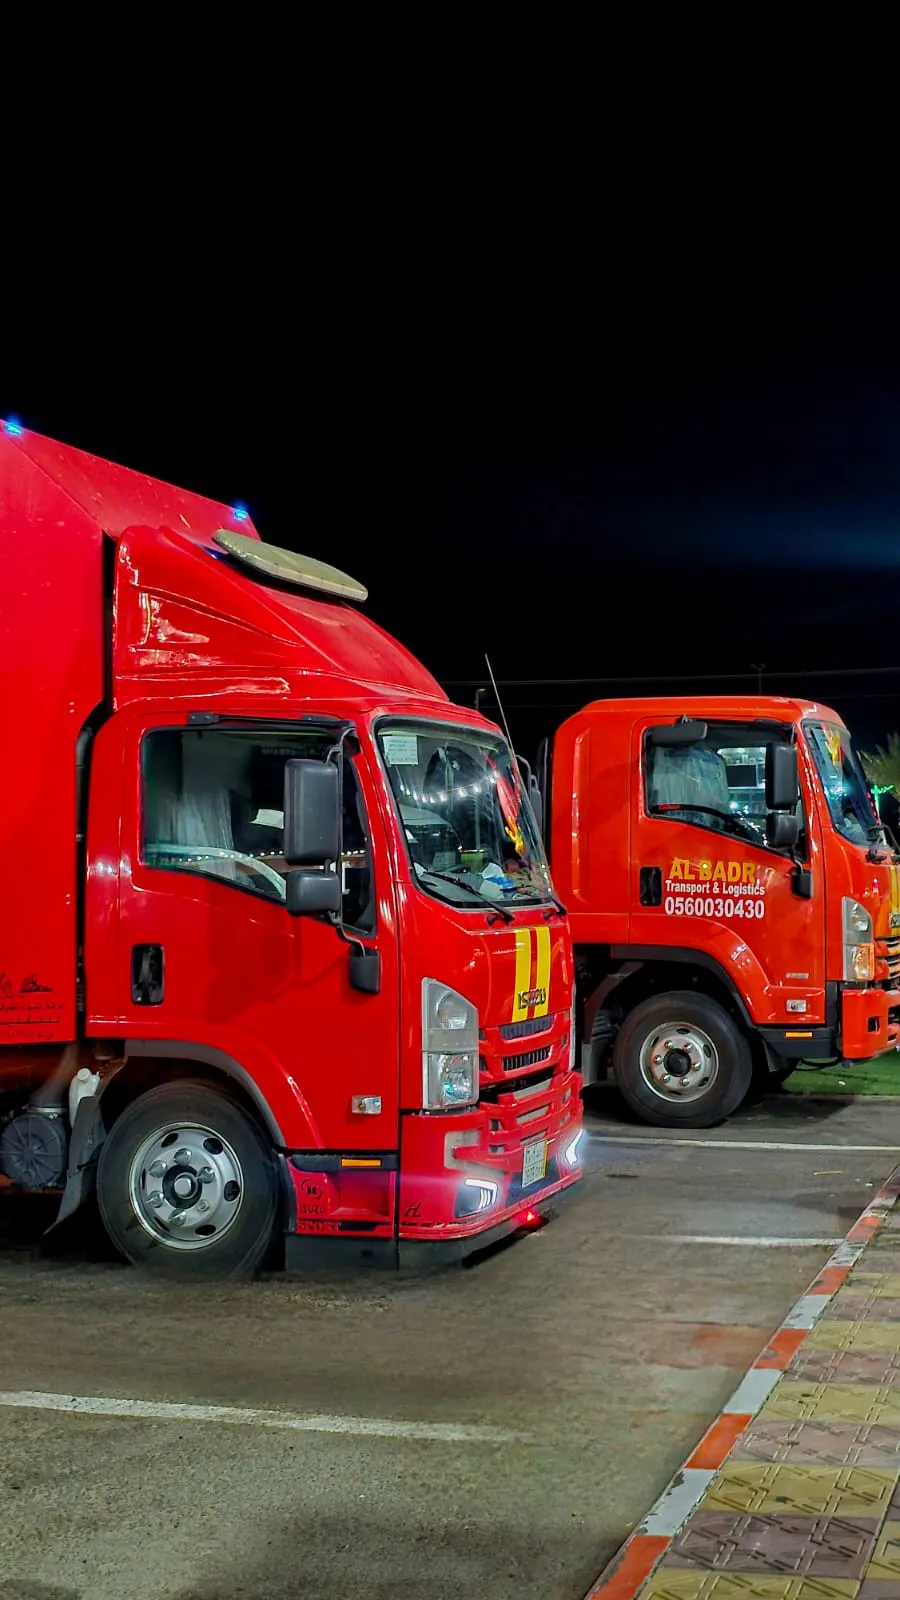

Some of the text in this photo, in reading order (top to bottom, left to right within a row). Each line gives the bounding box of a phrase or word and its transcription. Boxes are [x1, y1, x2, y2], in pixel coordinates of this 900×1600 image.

[669, 857, 756, 883] AL BADR
[665, 879, 765, 897] Transport & Logistics
[664, 896, 765, 918] 0560030430
[301, 1204, 325, 1215] ISUZU
